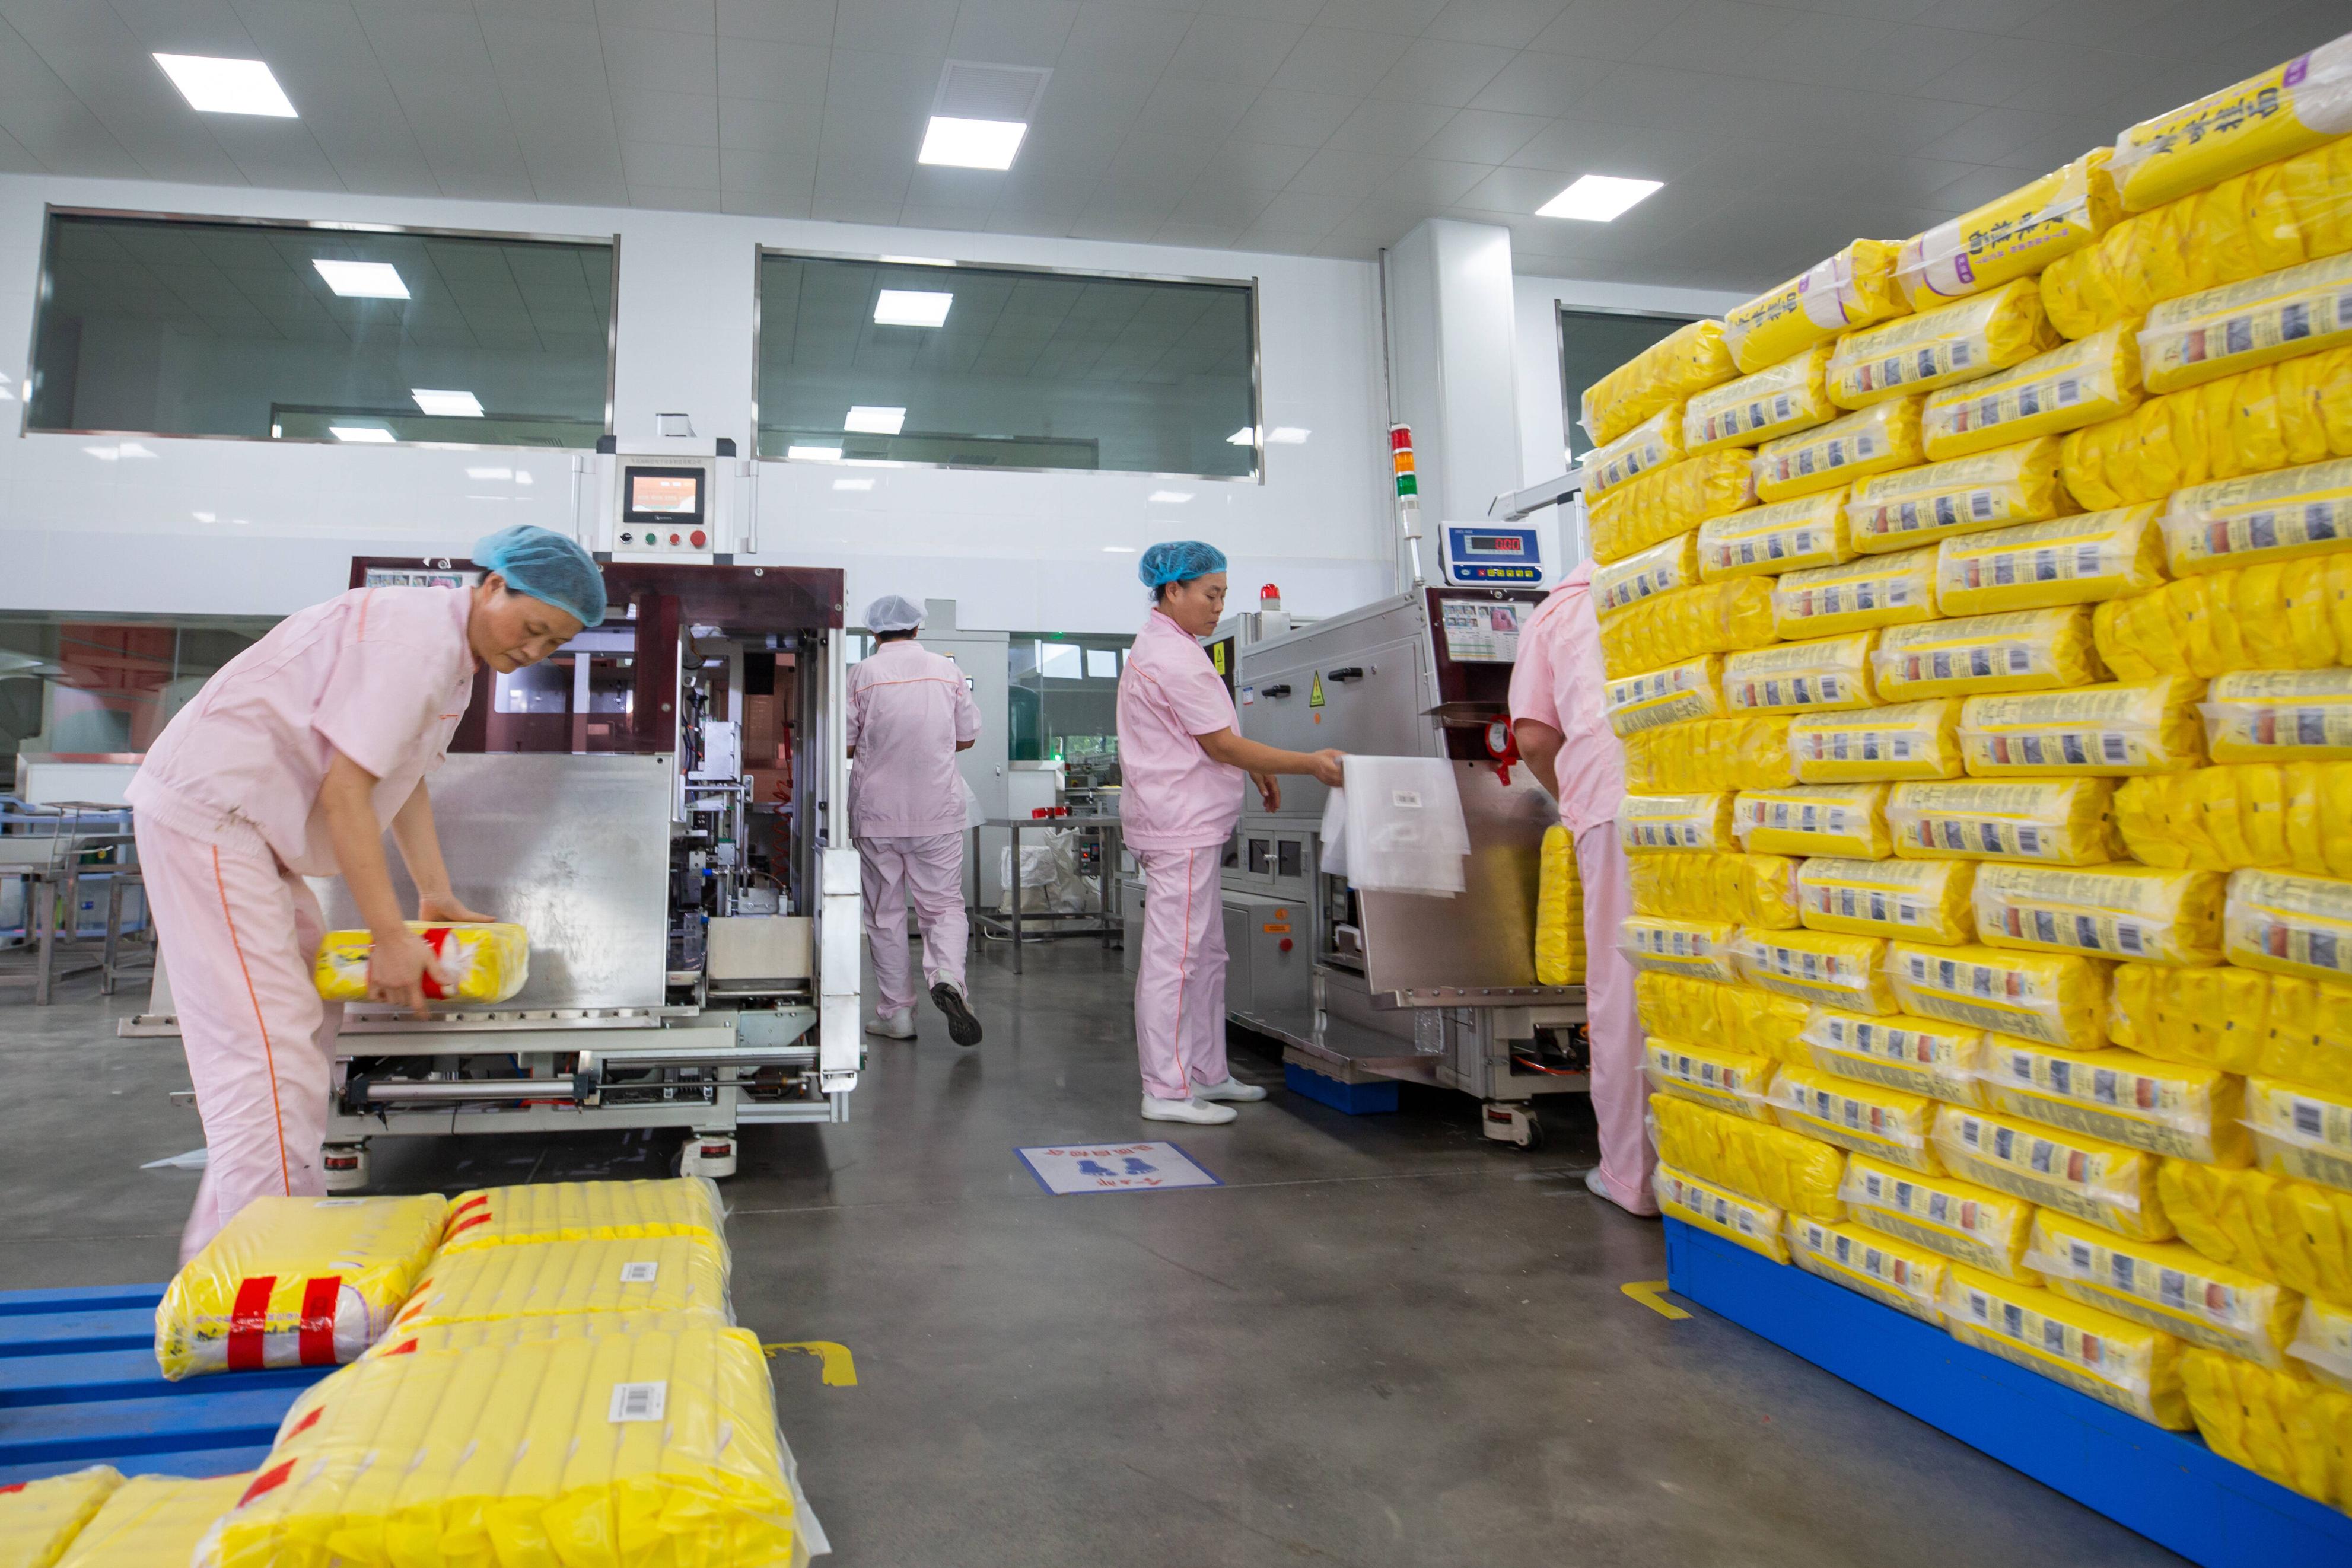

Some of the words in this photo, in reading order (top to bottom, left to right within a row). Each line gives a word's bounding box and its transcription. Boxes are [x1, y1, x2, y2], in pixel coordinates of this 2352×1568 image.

[1969, 202, 2067, 255] 味挂面
[1495, 538, 1520, 550] 0.00
